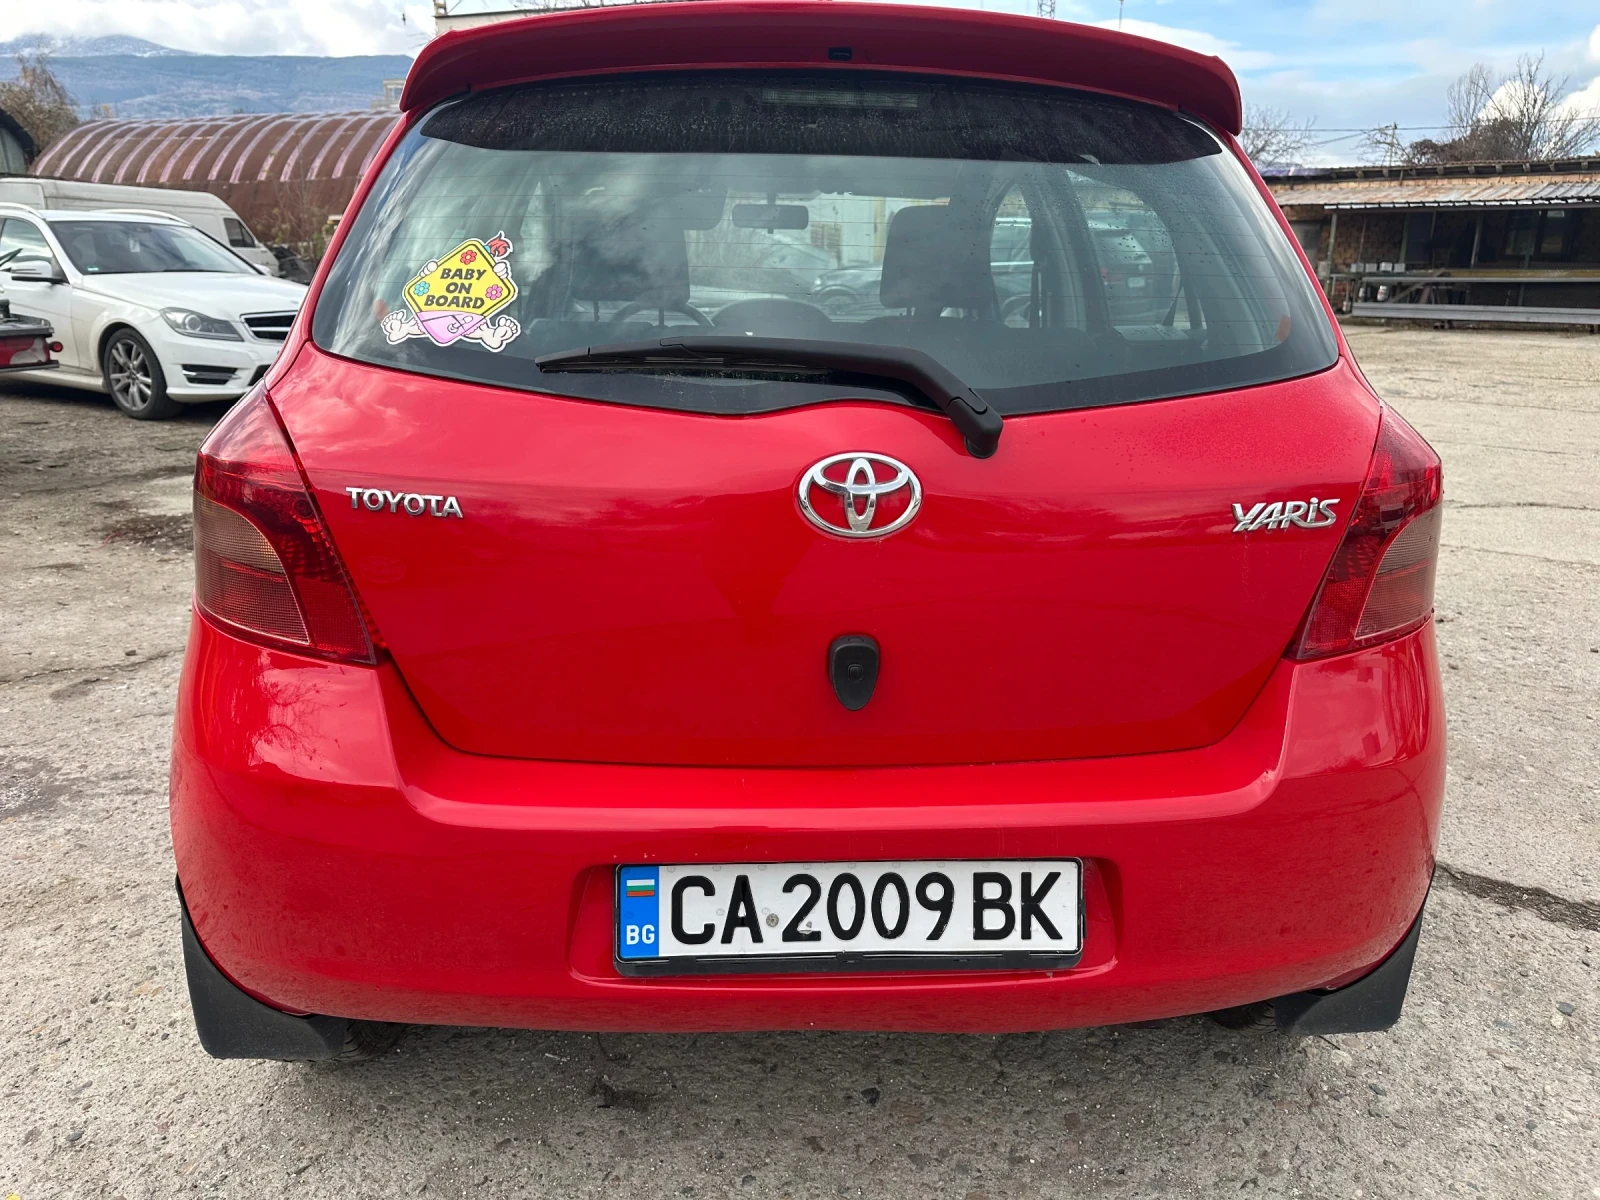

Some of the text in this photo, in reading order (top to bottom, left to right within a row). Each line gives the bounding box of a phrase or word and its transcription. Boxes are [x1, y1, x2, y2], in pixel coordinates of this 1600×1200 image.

[440, 268, 487, 281] BABY
[445, 282, 473, 295] ON
[424, 295, 485, 309] BOARD
[345, 486, 464, 519] TOYOTA
[670, 871, 1063, 945] CA 2009 BK
[625, 924, 656, 945] BG
